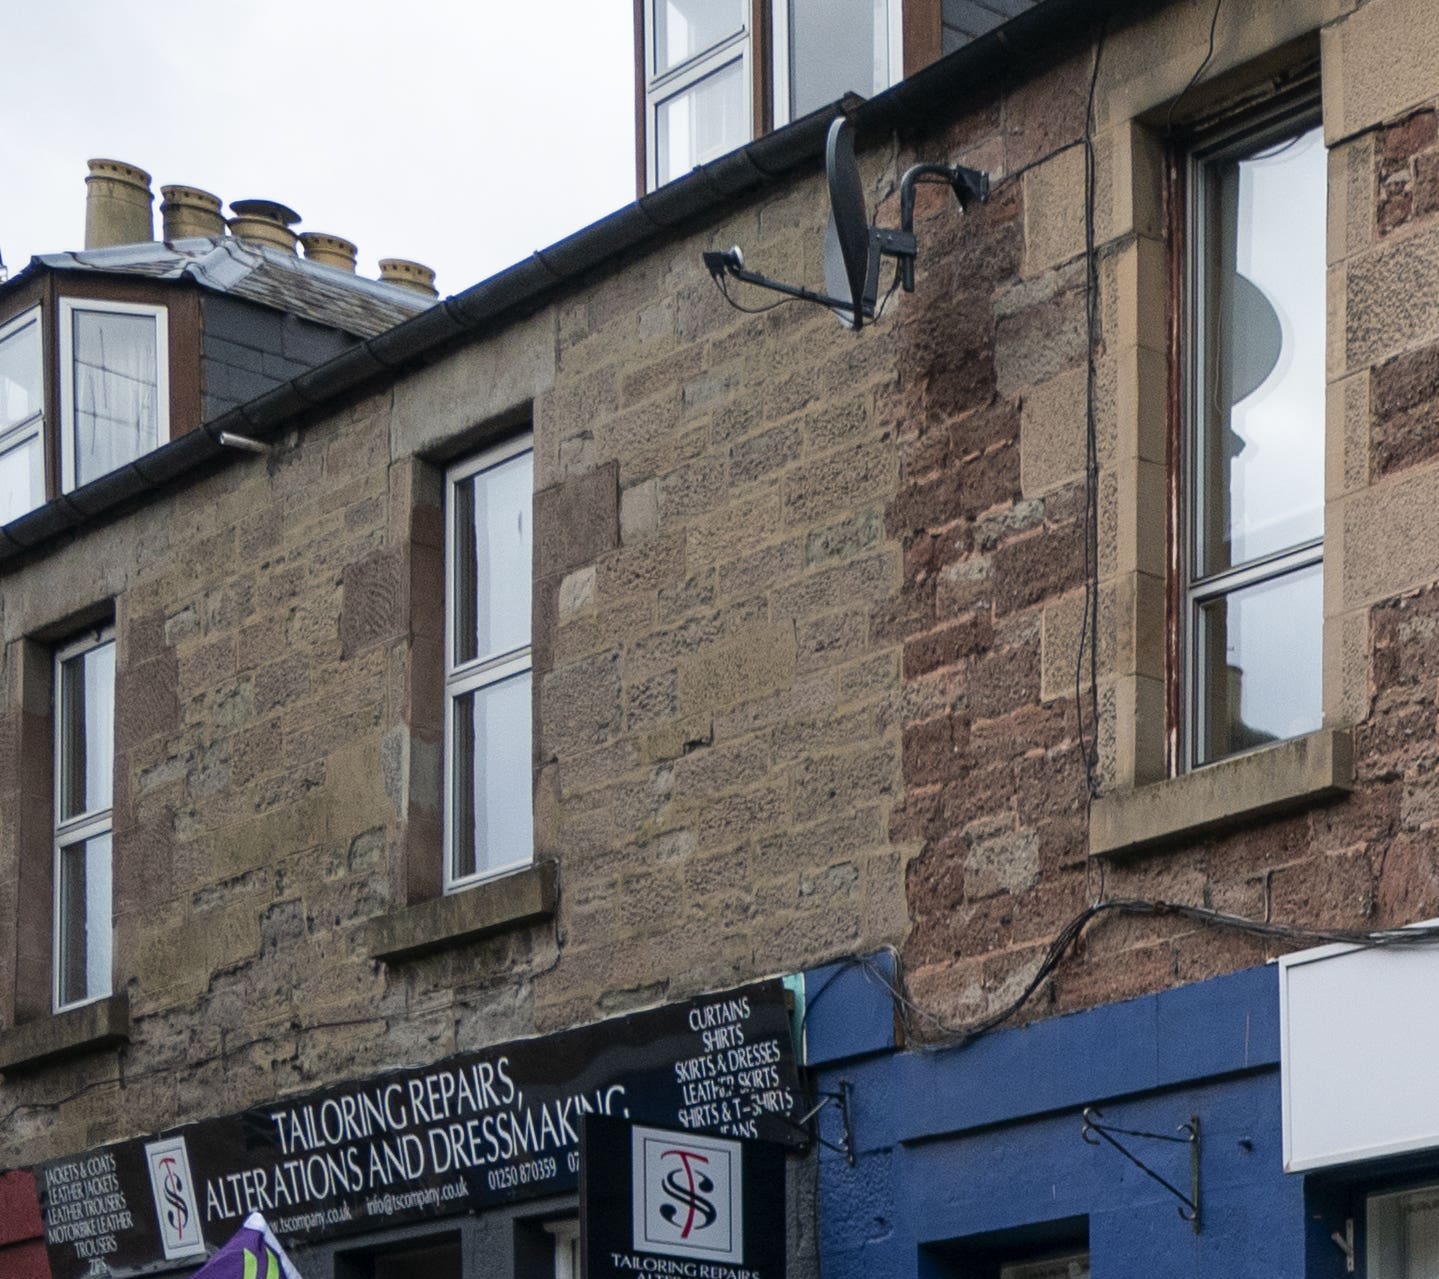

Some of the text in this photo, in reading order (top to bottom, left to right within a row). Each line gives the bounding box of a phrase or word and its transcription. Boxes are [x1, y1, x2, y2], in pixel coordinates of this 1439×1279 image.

[689, 996, 750, 1031] CURTAINS
[702, 1022, 744, 1053] SHIRTS
[675, 1055, 716, 1084] SKIRTS
[727, 1040, 781, 1072] DRESSES
[738, 1065, 780, 1090] SKIRTS
[271, 1057, 523, 1155] TAILORING REPAIRS,
[678, 1102, 719, 1129] SHIRTS
[45, 1164, 79, 1188] JACKETS
[87, 1152, 117, 1174] COATS
[207, 1146, 363, 1222] ALTERATIONS
[369, 1134, 425, 1188] AND
[366, 1175, 470, 1216] info@tscompany.co.uk
[487, 1165, 517, 1191] 01250
[519, 1156, 557, 1185] 870359
[48, 1173, 120, 1206] LEATHER JACKETS
[47, 1191, 128, 1227] LEATHER TROUSERS
[96, 1210, 134, 1234] LEATHER
[73, 1234, 119, 1259] TROUSERS
[611, 1253, 697, 1278] TAILORING
